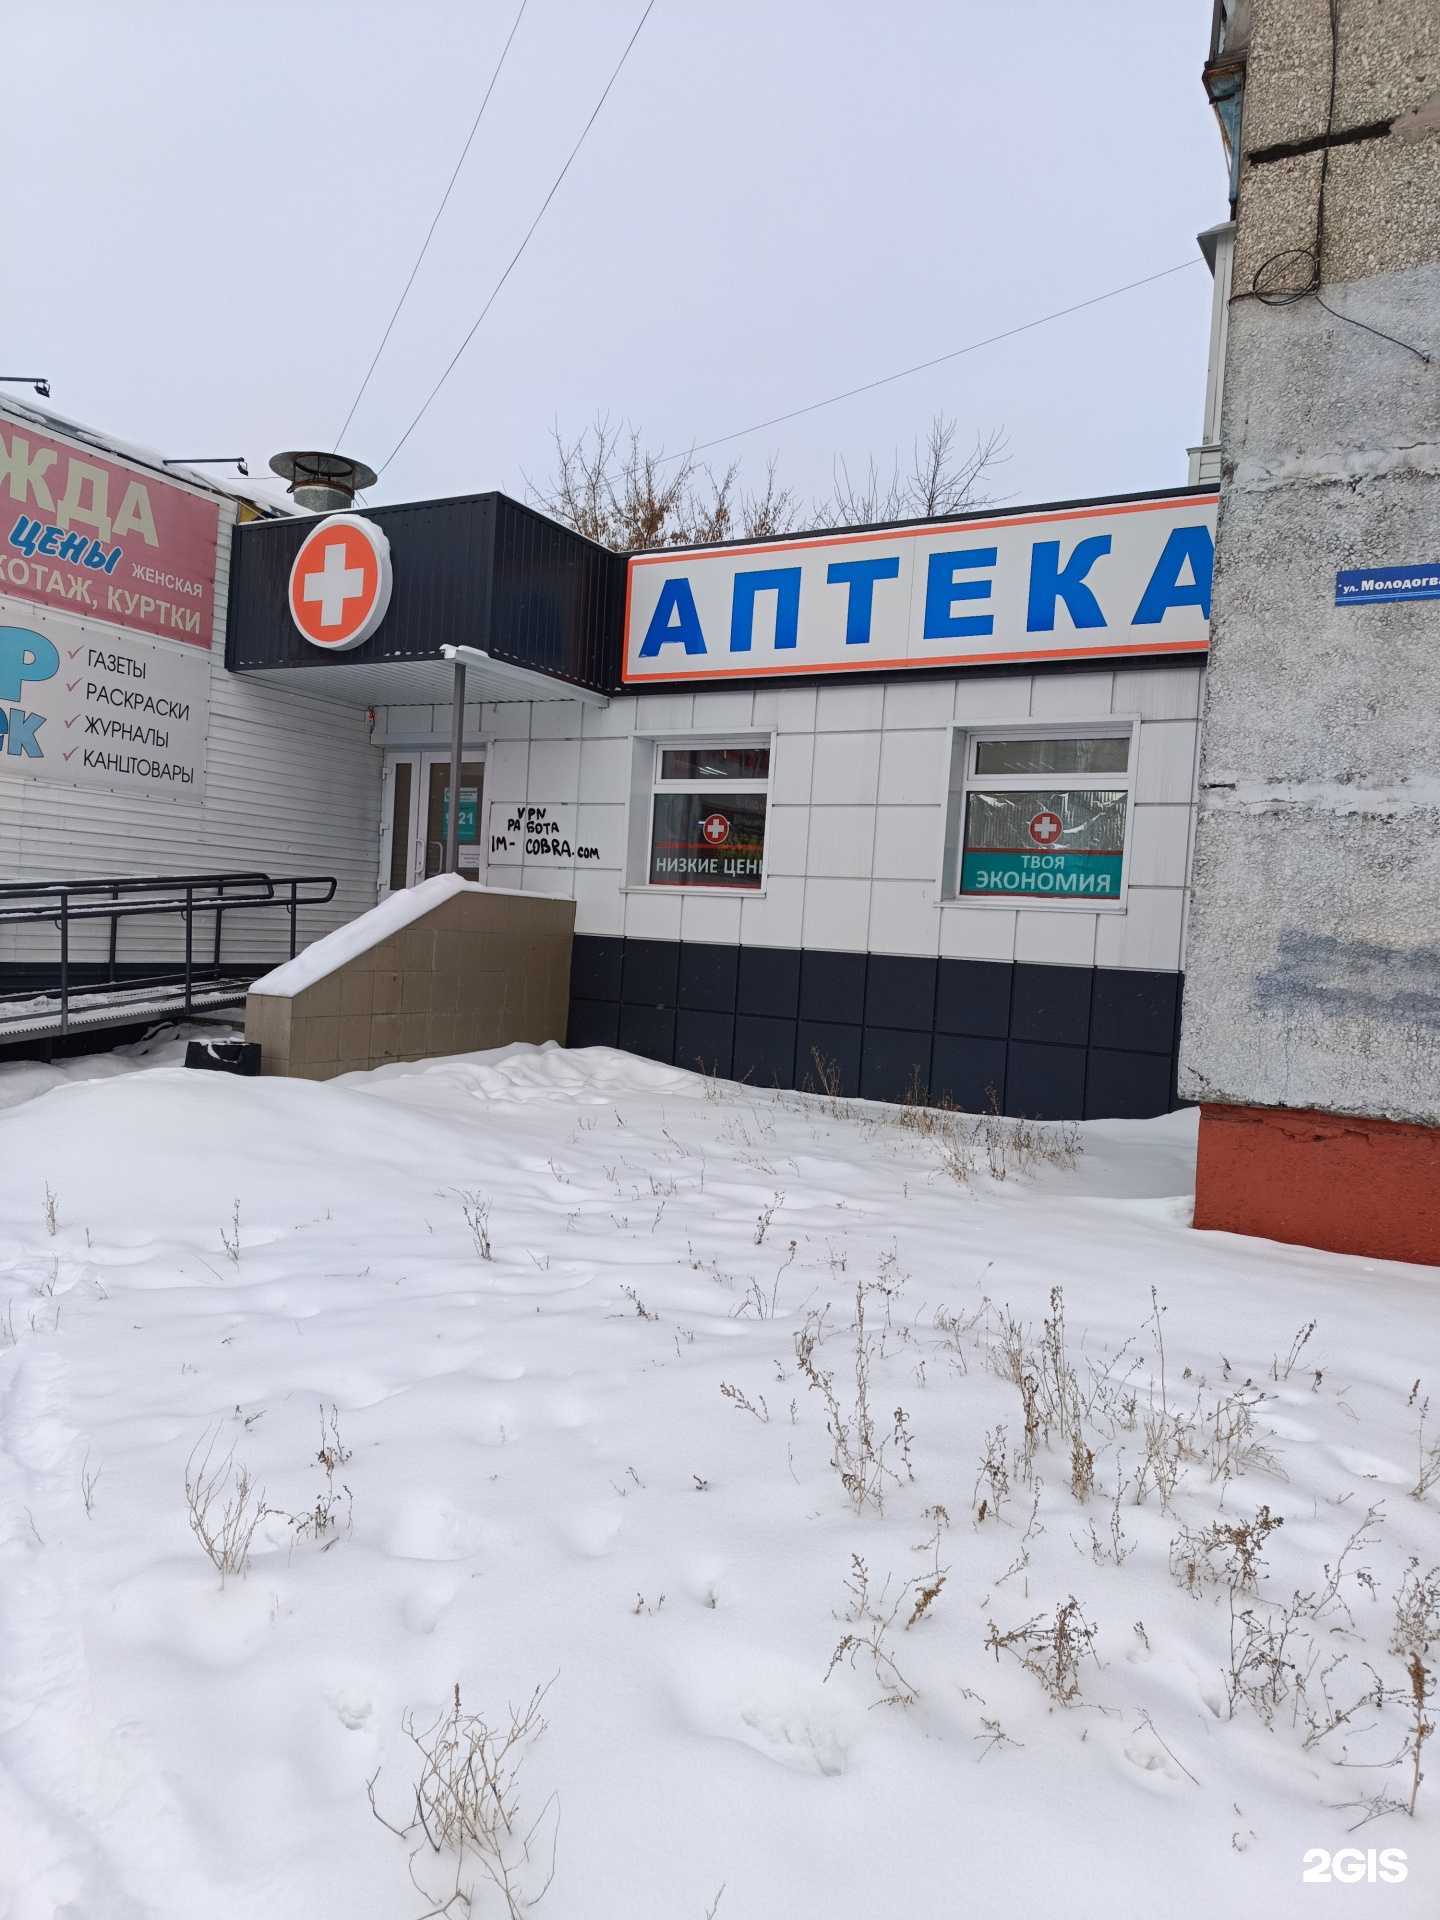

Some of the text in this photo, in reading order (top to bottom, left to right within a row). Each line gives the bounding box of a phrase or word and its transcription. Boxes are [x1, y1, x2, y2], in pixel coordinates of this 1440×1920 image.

[9, 514, 123, 575] ЦЕНЫ
[131, 562, 203, 599] ЖЕНСКАЯ
[638, 525, 1215, 658] АПТЕКА
[1343, 576, 1440, 594] ул. Молодогв
[107, 585, 201, 635] КУРТКИ
[88, 649, 146, 679] ГАЗЕТЫ
[86, 682, 190, 721] РАСКРАСКИ
[84, 715, 169, 748] ЖУРНАЛЫ
[83, 749, 194, 784] КАНЦТОВАРЫ
[517, 807, 547, 820] VPN
[656, 857, 718, 874] НИЗКИЕ
[1021, 855, 1065, 870] ТВОЯ
[975, 870, 1111, 893] ЭКОНОМИЯ
